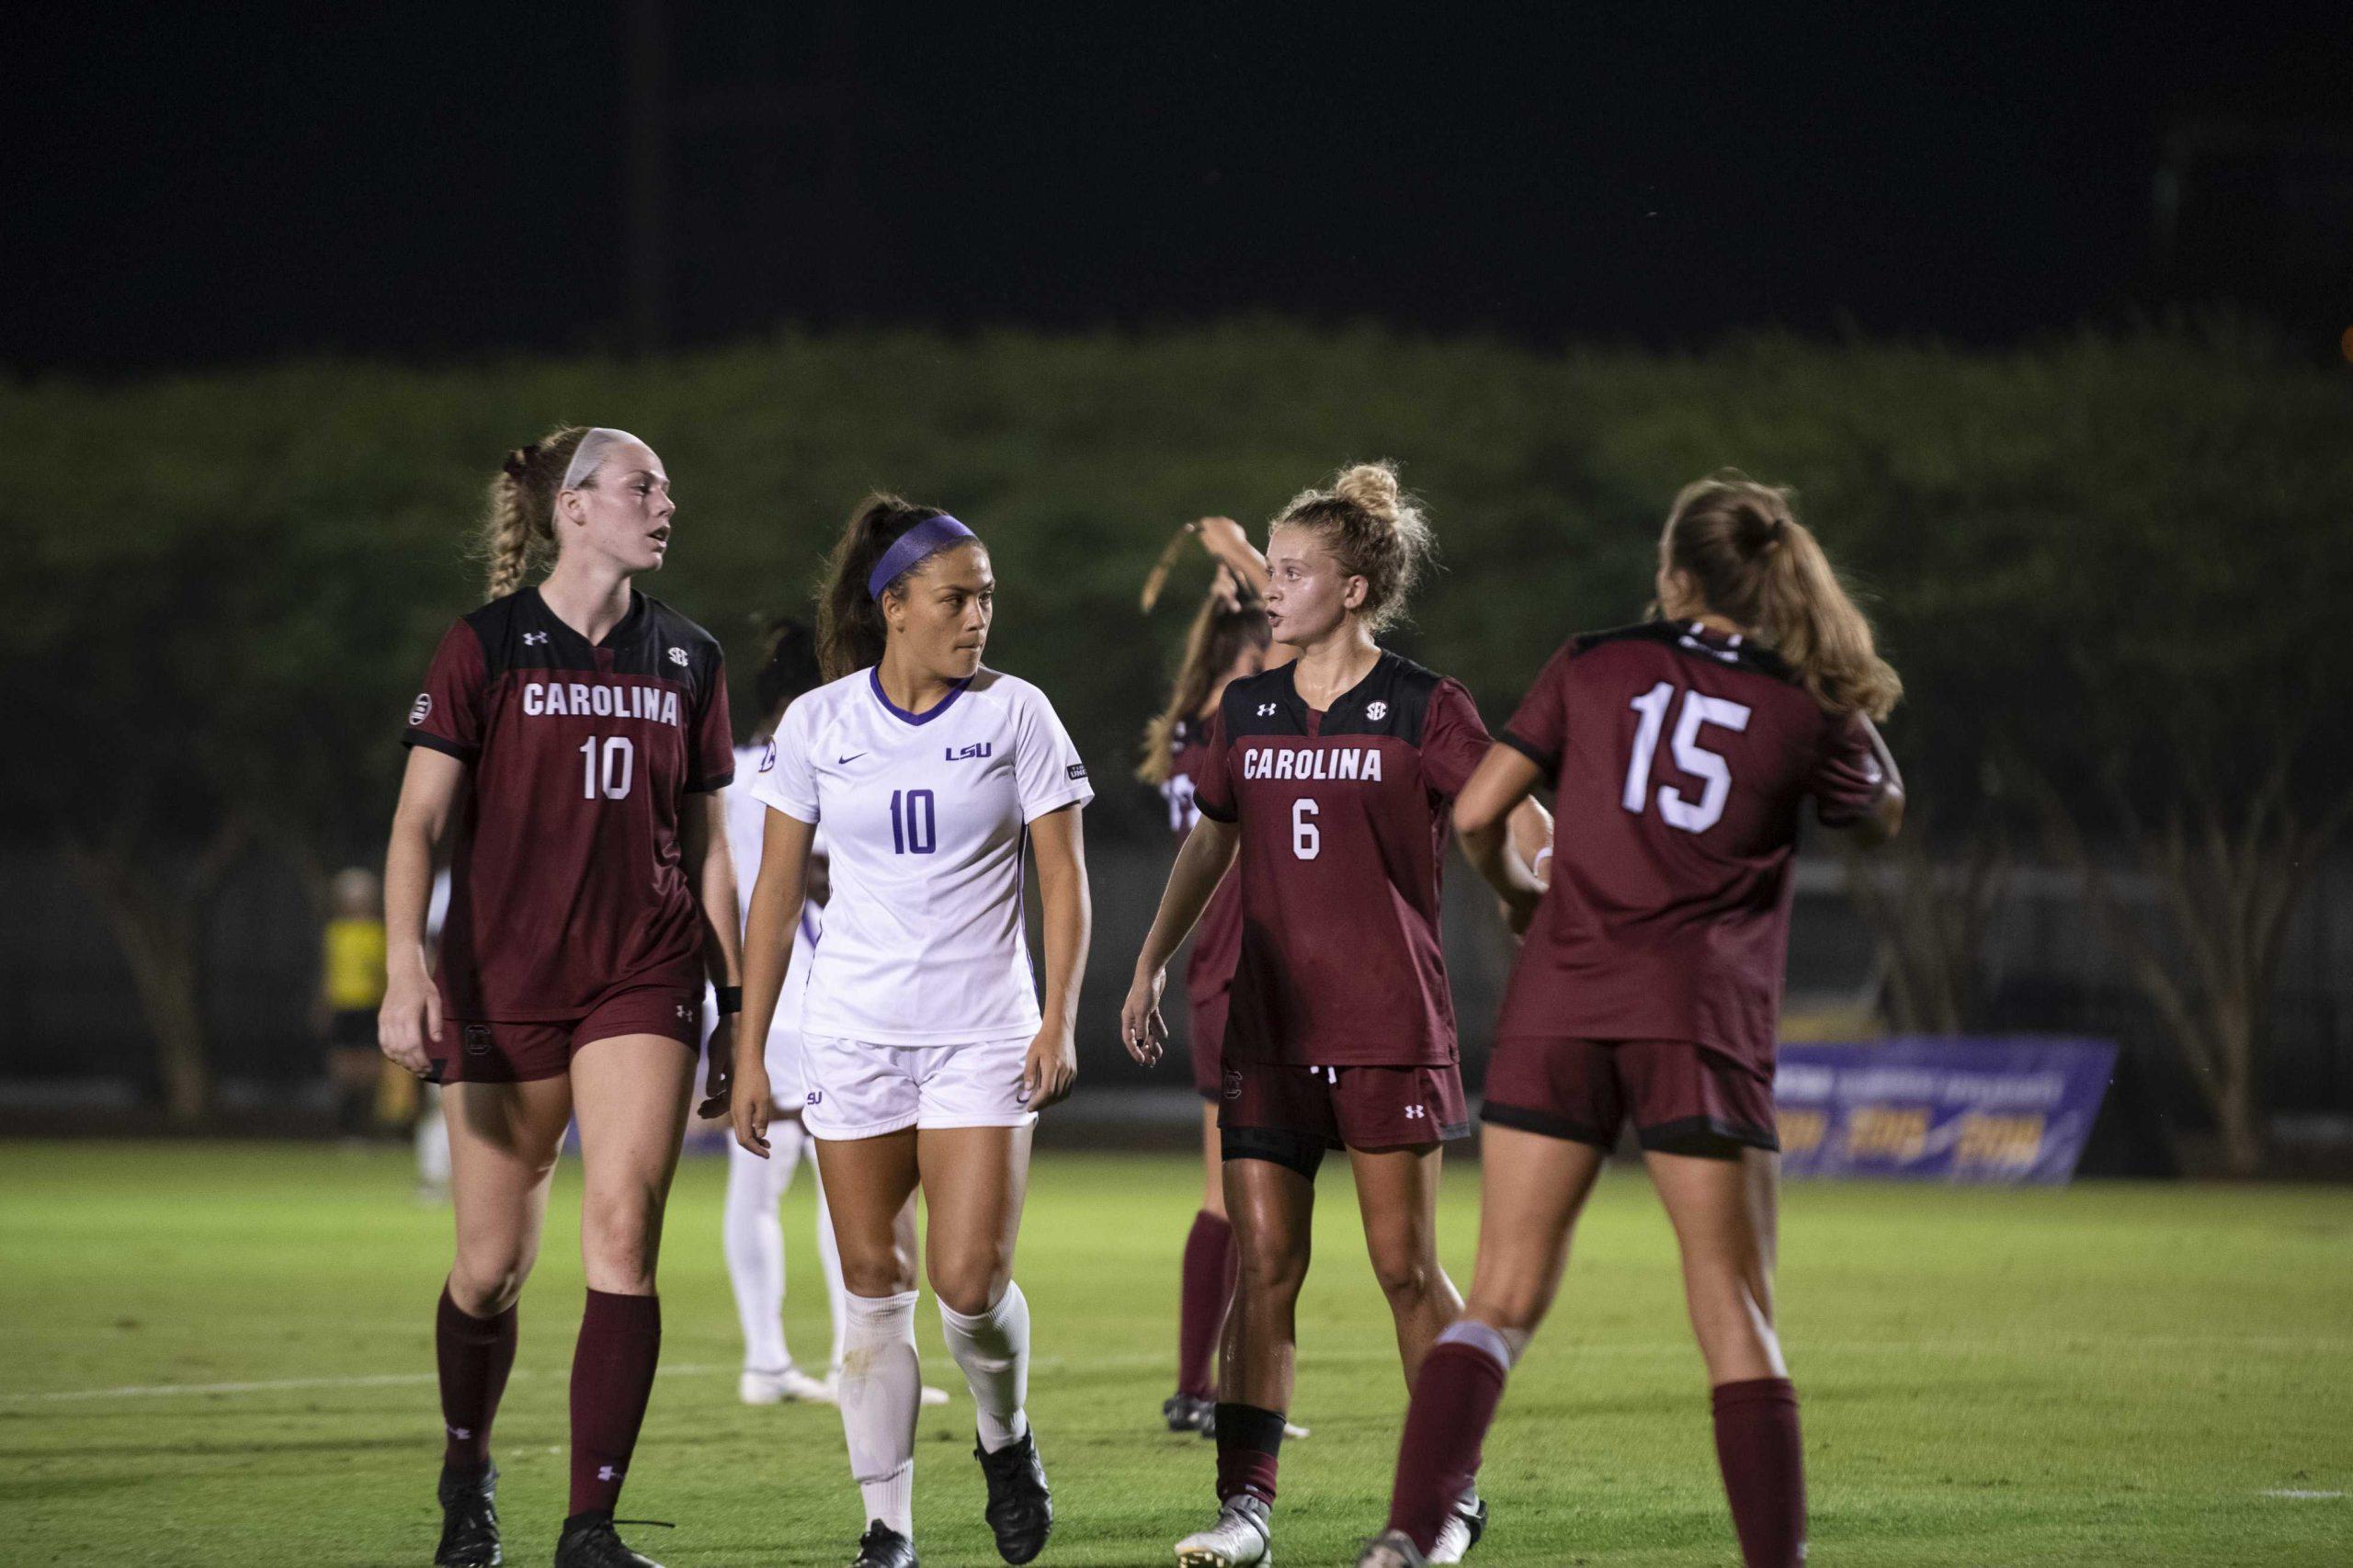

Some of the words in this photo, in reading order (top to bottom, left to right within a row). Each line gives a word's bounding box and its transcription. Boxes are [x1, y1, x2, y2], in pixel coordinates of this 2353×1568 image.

[668, 647, 688, 666] SEC
[523, 683, 678, 726] CAROLINA
[1367, 701, 1386, 721] SEC
[579, 735, 633, 800] 10
[946, 742, 992, 761] LSU
[1245, 748, 1381, 781] CAROLINA
[1621, 681, 1751, 834] 15
[890, 790, 936, 855] 10
[1292, 798, 1320, 860] 6
